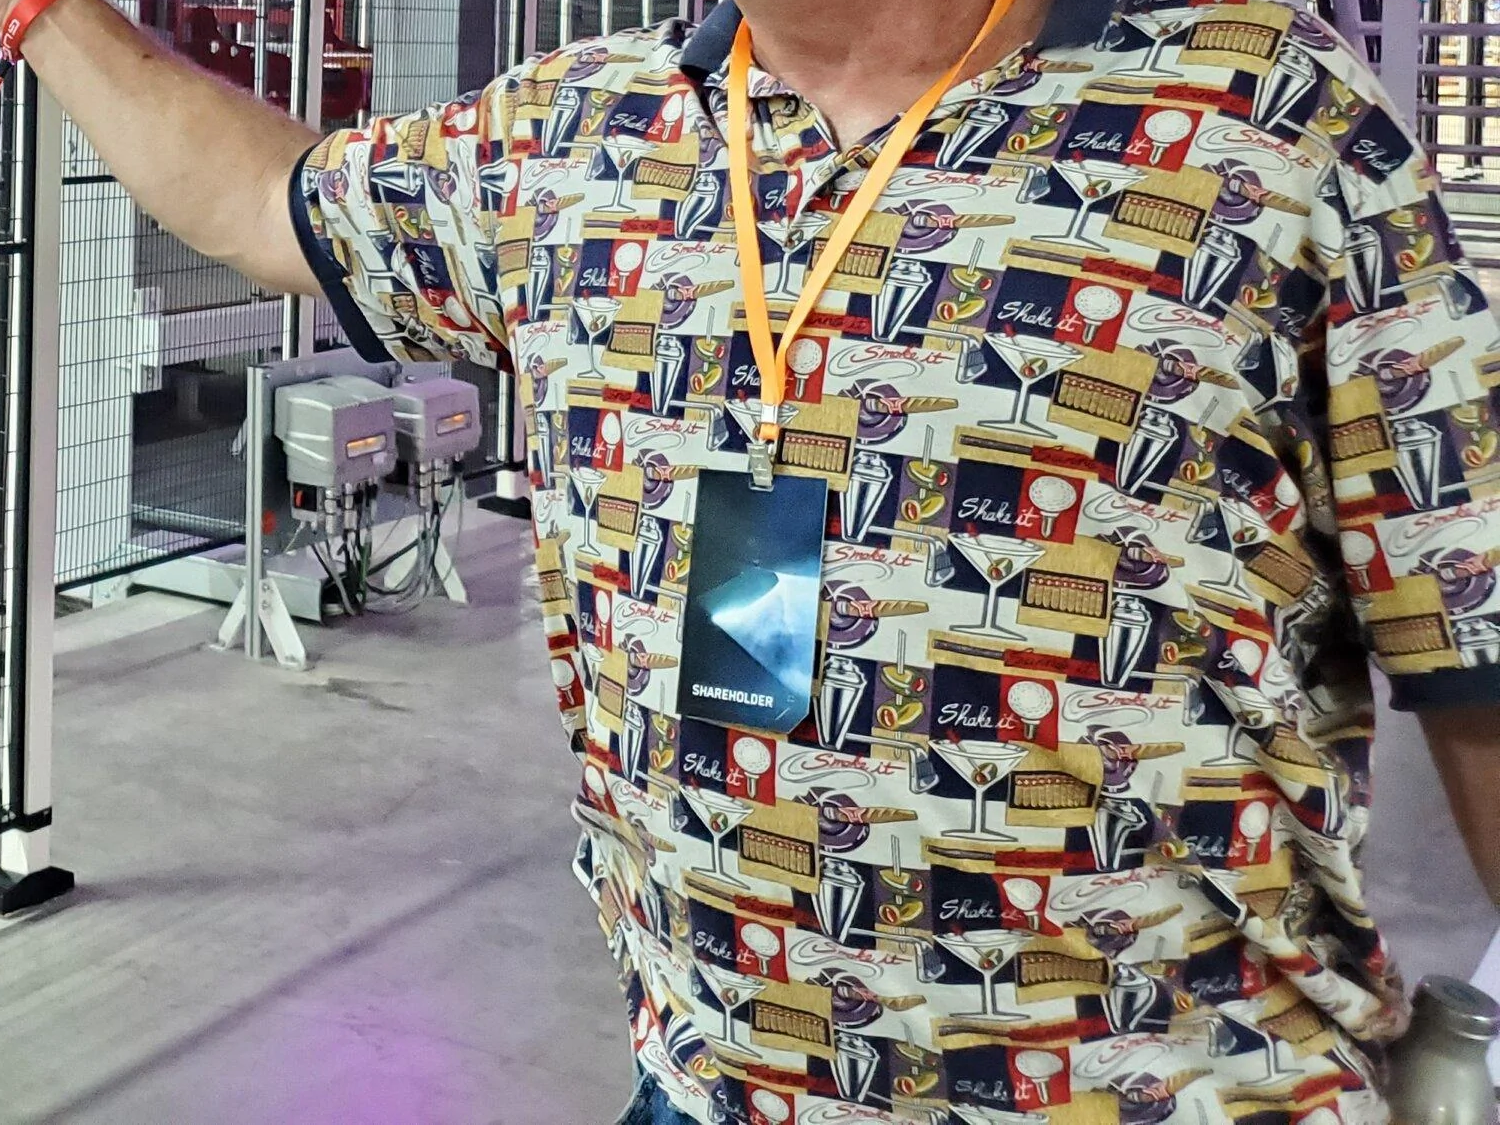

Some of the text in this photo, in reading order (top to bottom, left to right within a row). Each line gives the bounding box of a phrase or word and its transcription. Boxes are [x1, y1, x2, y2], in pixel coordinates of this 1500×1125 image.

[647, 121, 664, 134] it
[1068, 130, 1152, 156] Shake it
[906, 171, 1021, 188] Smoke it
[707, 244, 736, 255] it
[998, 300, 1083, 333] Shake it
[850, 344, 955, 365] Smoke it
[732, 365, 762, 387] Sha
[681, 423, 706, 435] it
[592, 441, 605, 458] it
[957, 496, 1040, 528] Shake it
[1157, 508, 1190, 523] it
[823, 545, 924, 567] Smoke it
[655, 611, 678, 624] it
[691, 683, 774, 708] SHAREHOLDER
[1150, 696, 1183, 710] it
[937, 703, 1020, 731] Shake it
[683, 753, 747, 787] Shake it
[801, 752, 907, 776] Smoke it
[938, 898, 998, 920] Shake
[693, 931, 735, 961] Shake
[735, 947, 758, 966] it
[880, 954, 914, 966] it
[1013, 1081, 1035, 1101] it
